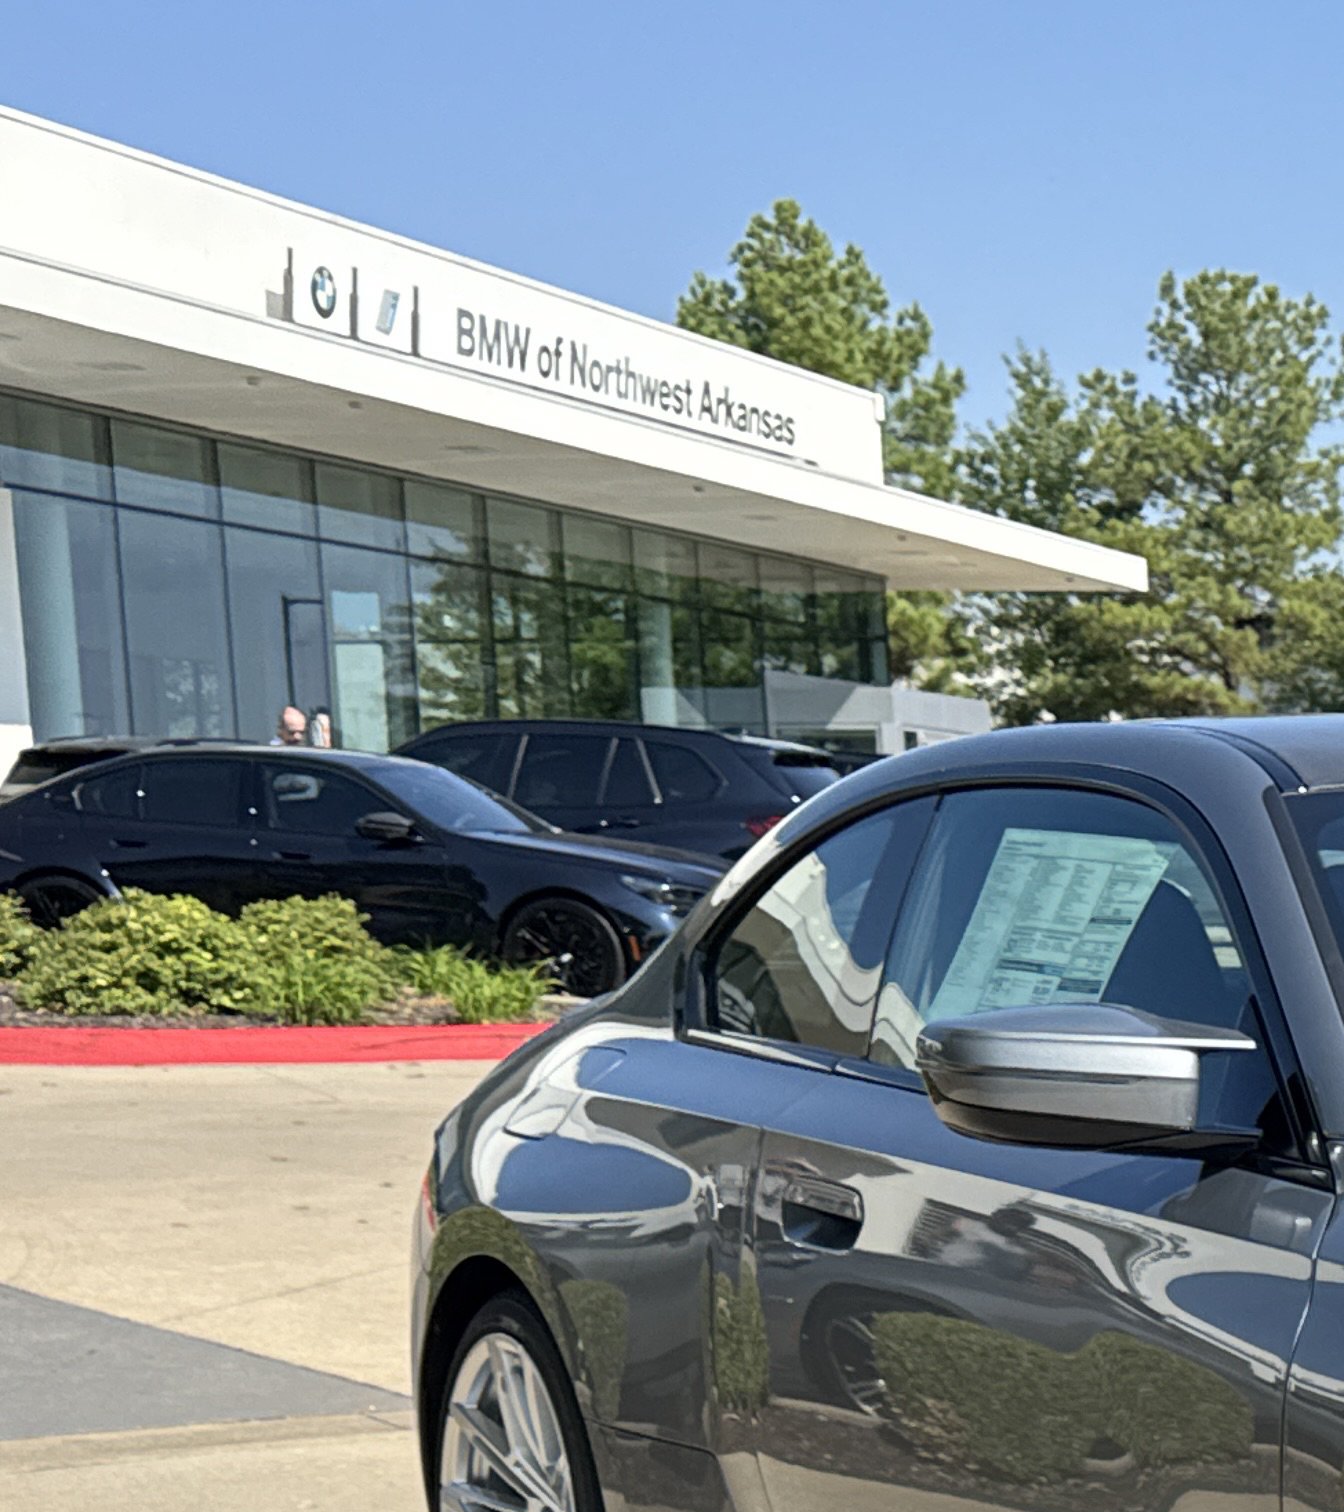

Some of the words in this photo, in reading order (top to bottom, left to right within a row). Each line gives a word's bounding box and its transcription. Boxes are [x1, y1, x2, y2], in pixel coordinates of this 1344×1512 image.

[456, 307, 531, 372] BMW
[537, 336, 563, 381] of
[569, 340, 692, 418] Northwest
[699, 380, 795, 445] Arkansas
